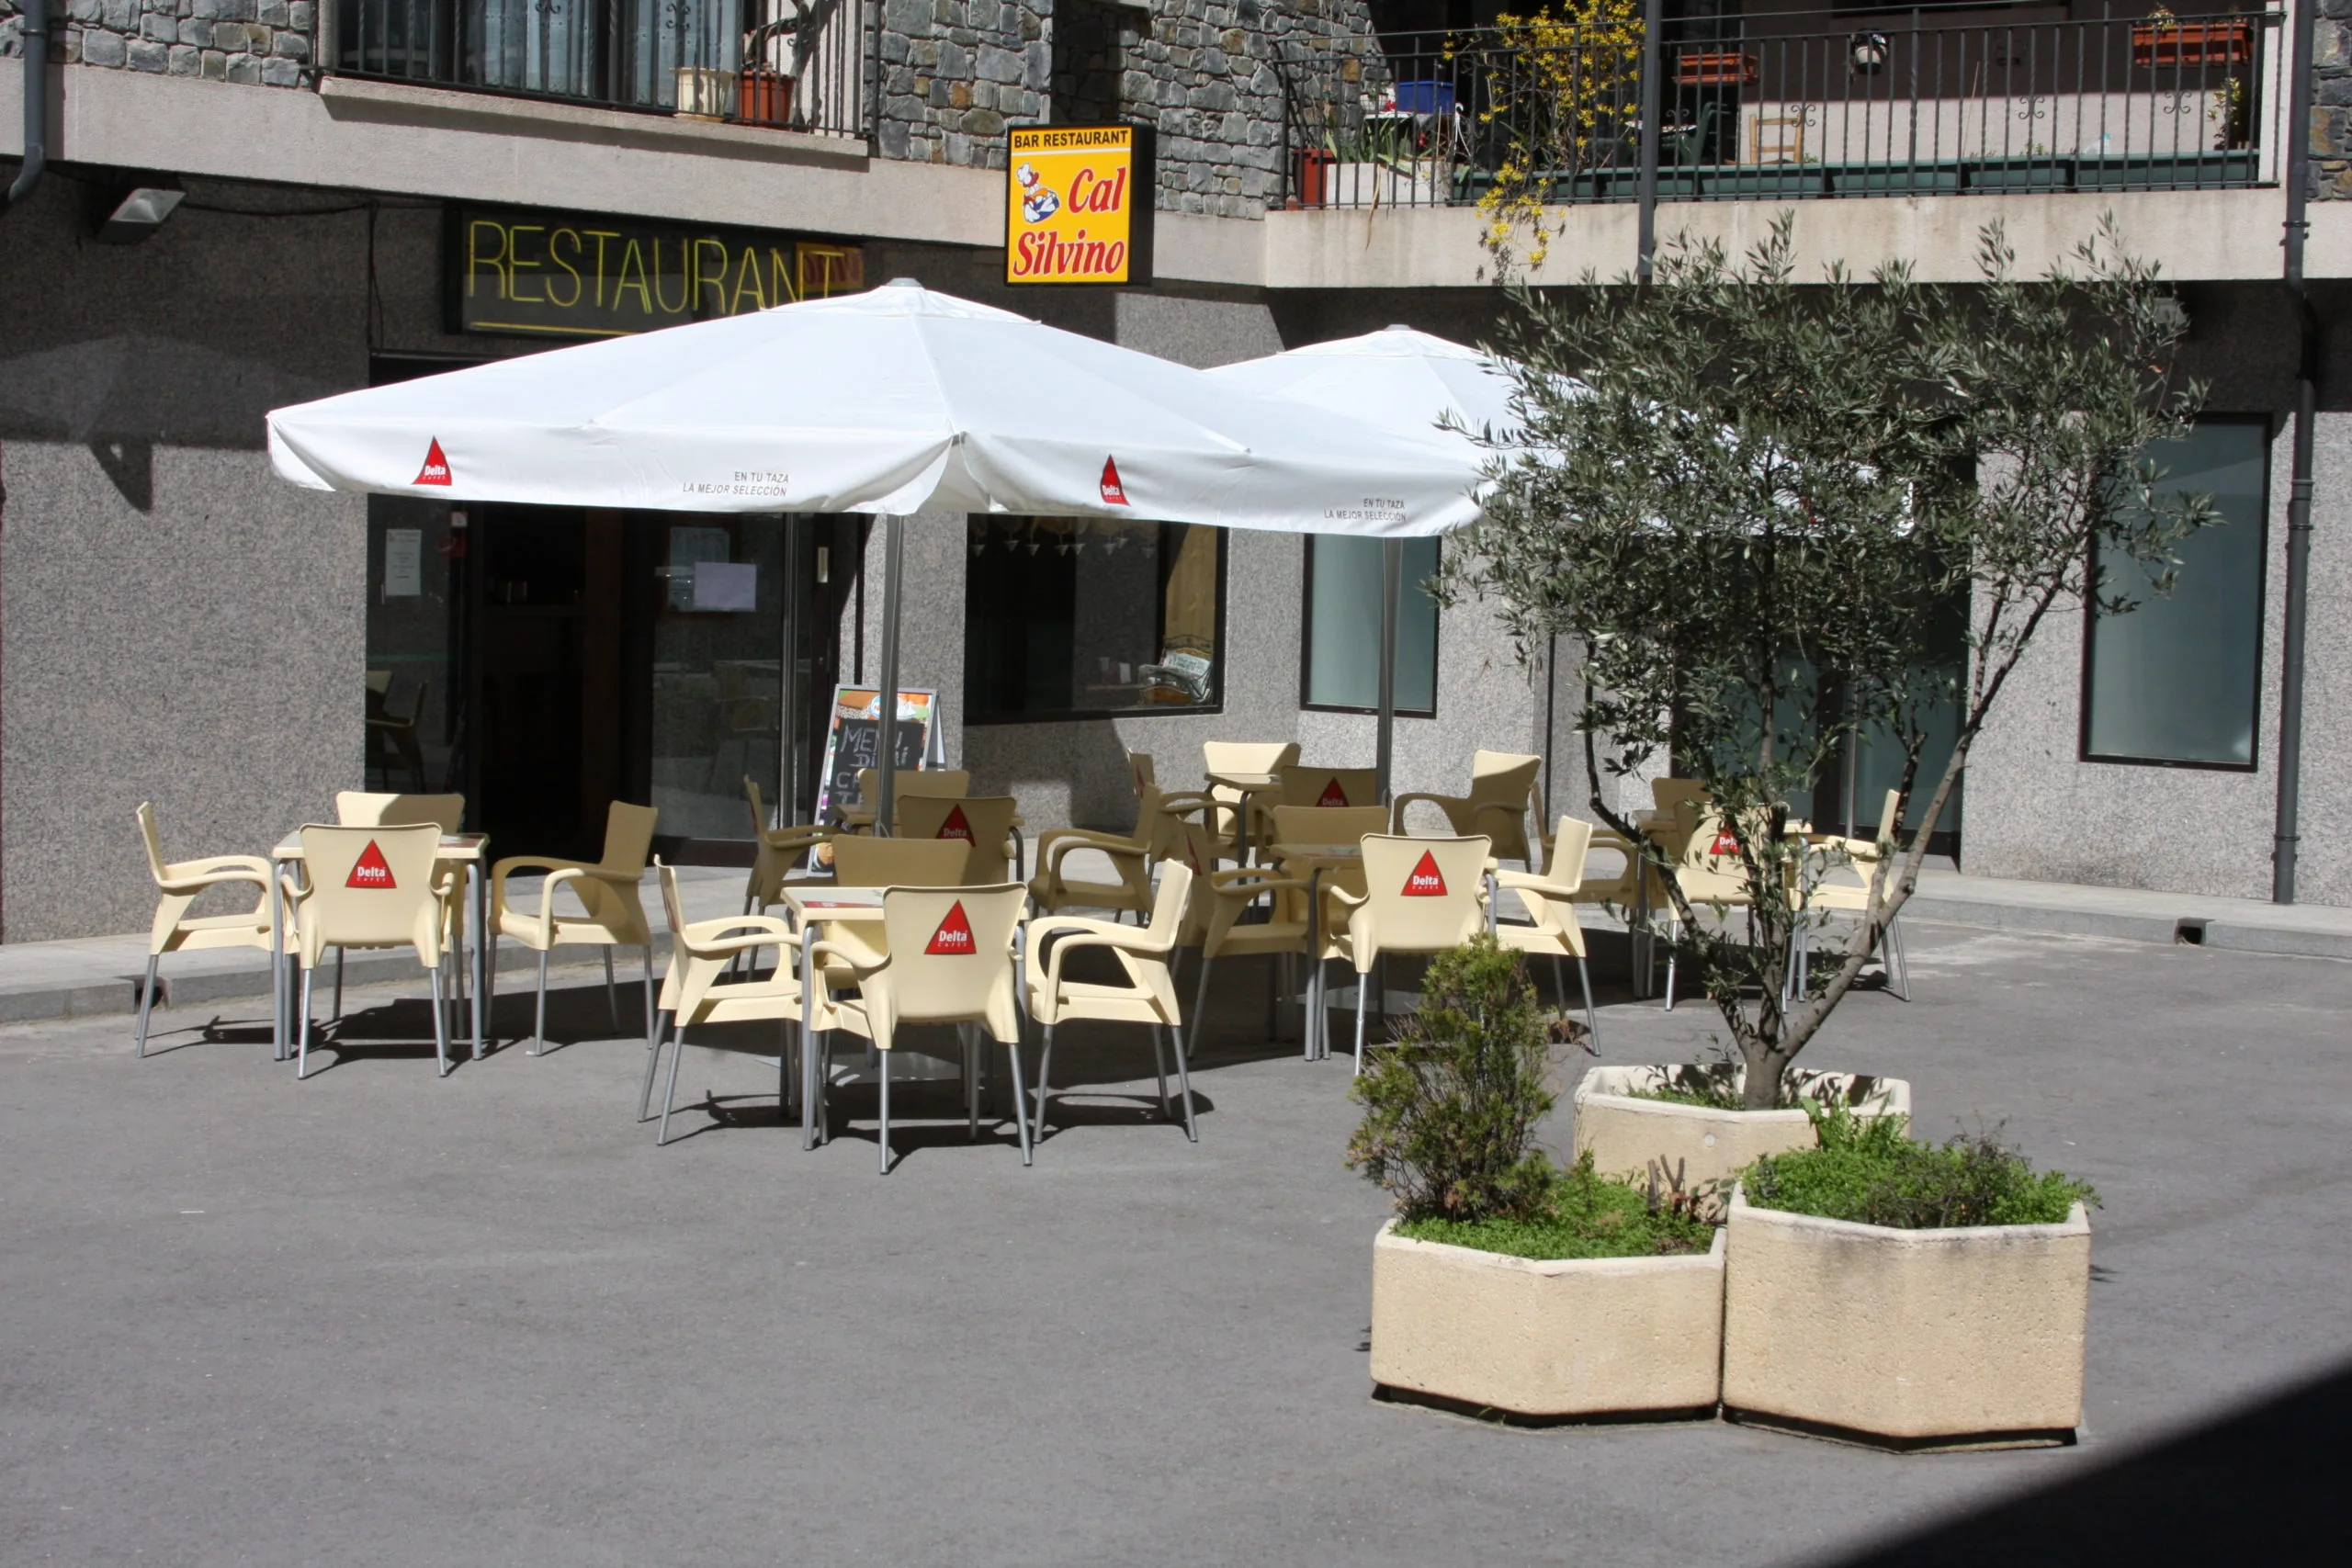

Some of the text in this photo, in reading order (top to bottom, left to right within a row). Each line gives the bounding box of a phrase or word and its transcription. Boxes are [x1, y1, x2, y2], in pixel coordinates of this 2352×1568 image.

[1014, 130, 1129, 149] BAR RESTAURANT
[1069, 167, 1126, 213] Cal
[1013, 230, 1125, 276] Silvino
[467, 220, 845, 315] RESTAURANT
[424, 464, 447, 476] Delta
[734, 470, 789, 483] EN TU TAZA
[683, 482, 695, 493] LA
[697, 483, 730, 494] MEJOR
[1363, 498, 1405, 510] EN TU TAZA
[1324, 509, 1334, 519] LA
[1337, 510, 1363, 520] MEJOR
[840, 724, 903, 753] ME
[357, 866, 386, 877] Delta
[1412, 874, 1439, 886] Delta
[939, 930, 967, 942] Delta
